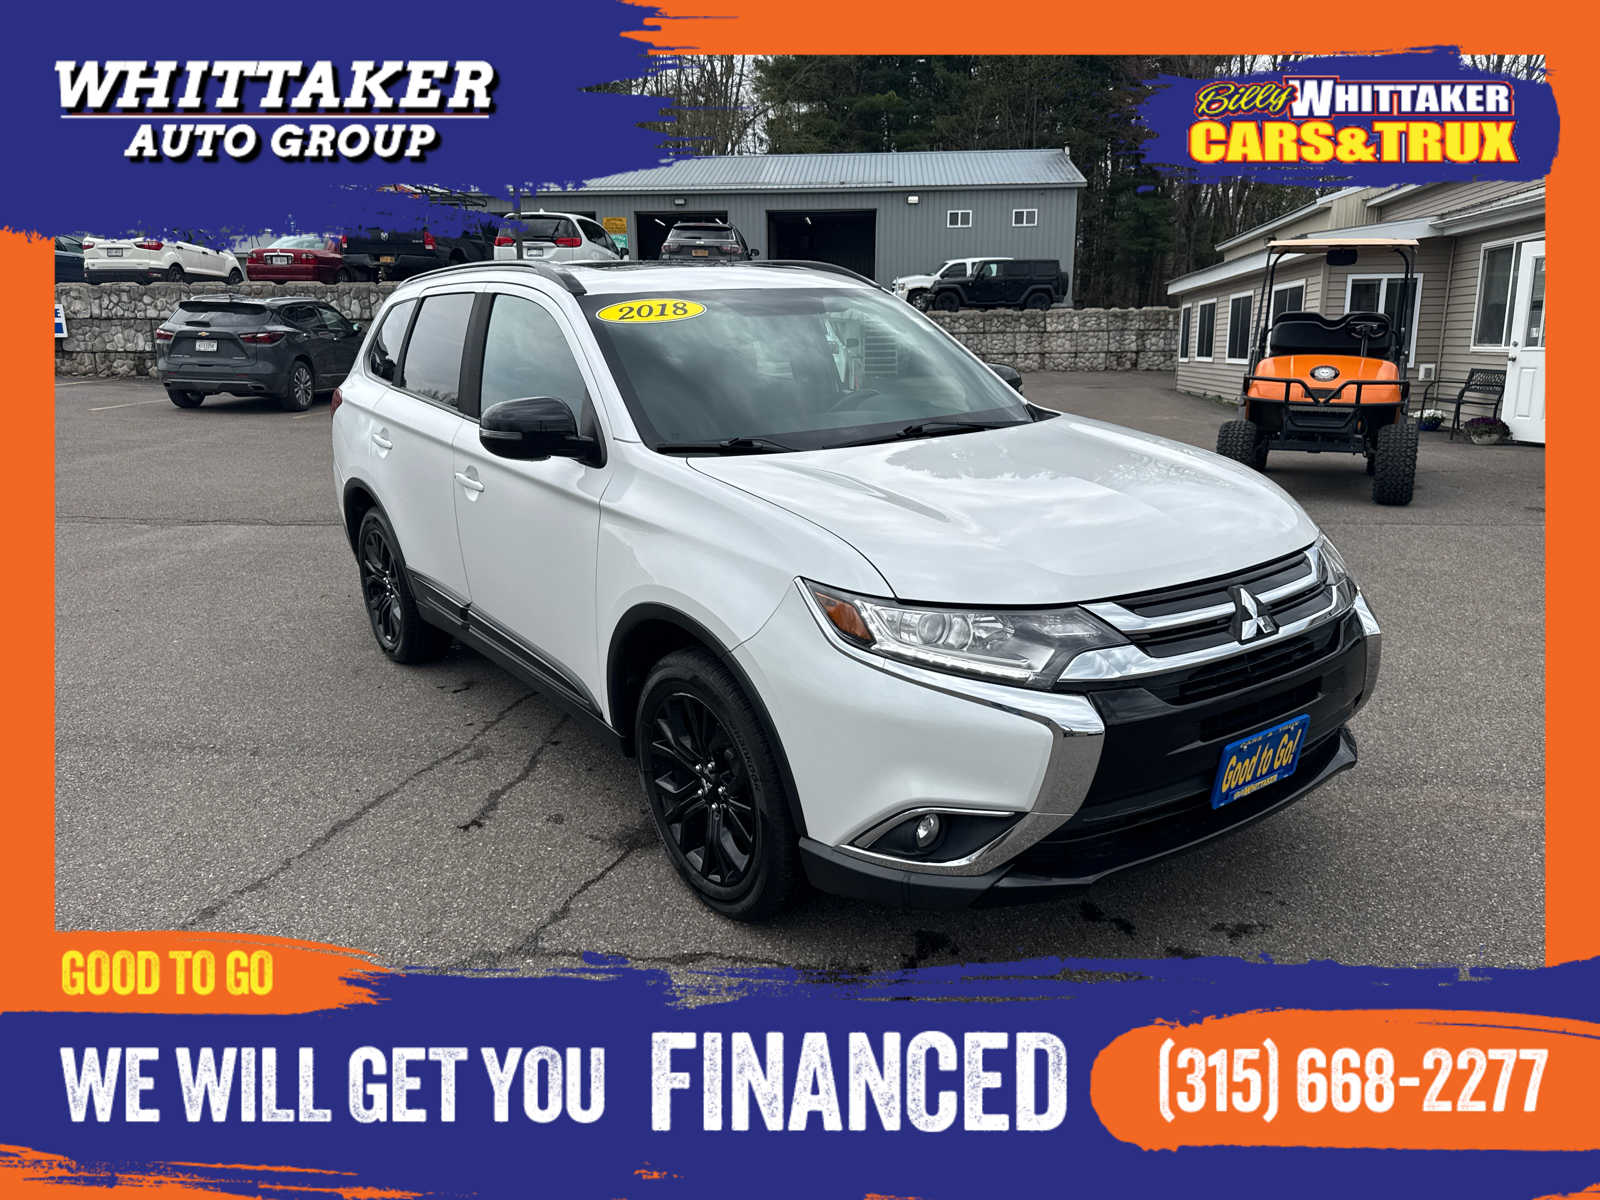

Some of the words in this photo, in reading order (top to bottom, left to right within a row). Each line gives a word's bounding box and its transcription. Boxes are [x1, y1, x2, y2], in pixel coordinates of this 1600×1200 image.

[618, 302, 688, 320] 2018
[1222, 745, 1261, 793] Good
[1256, 743, 1274, 777] to
[1273, 728, 1302, 770] Go!
